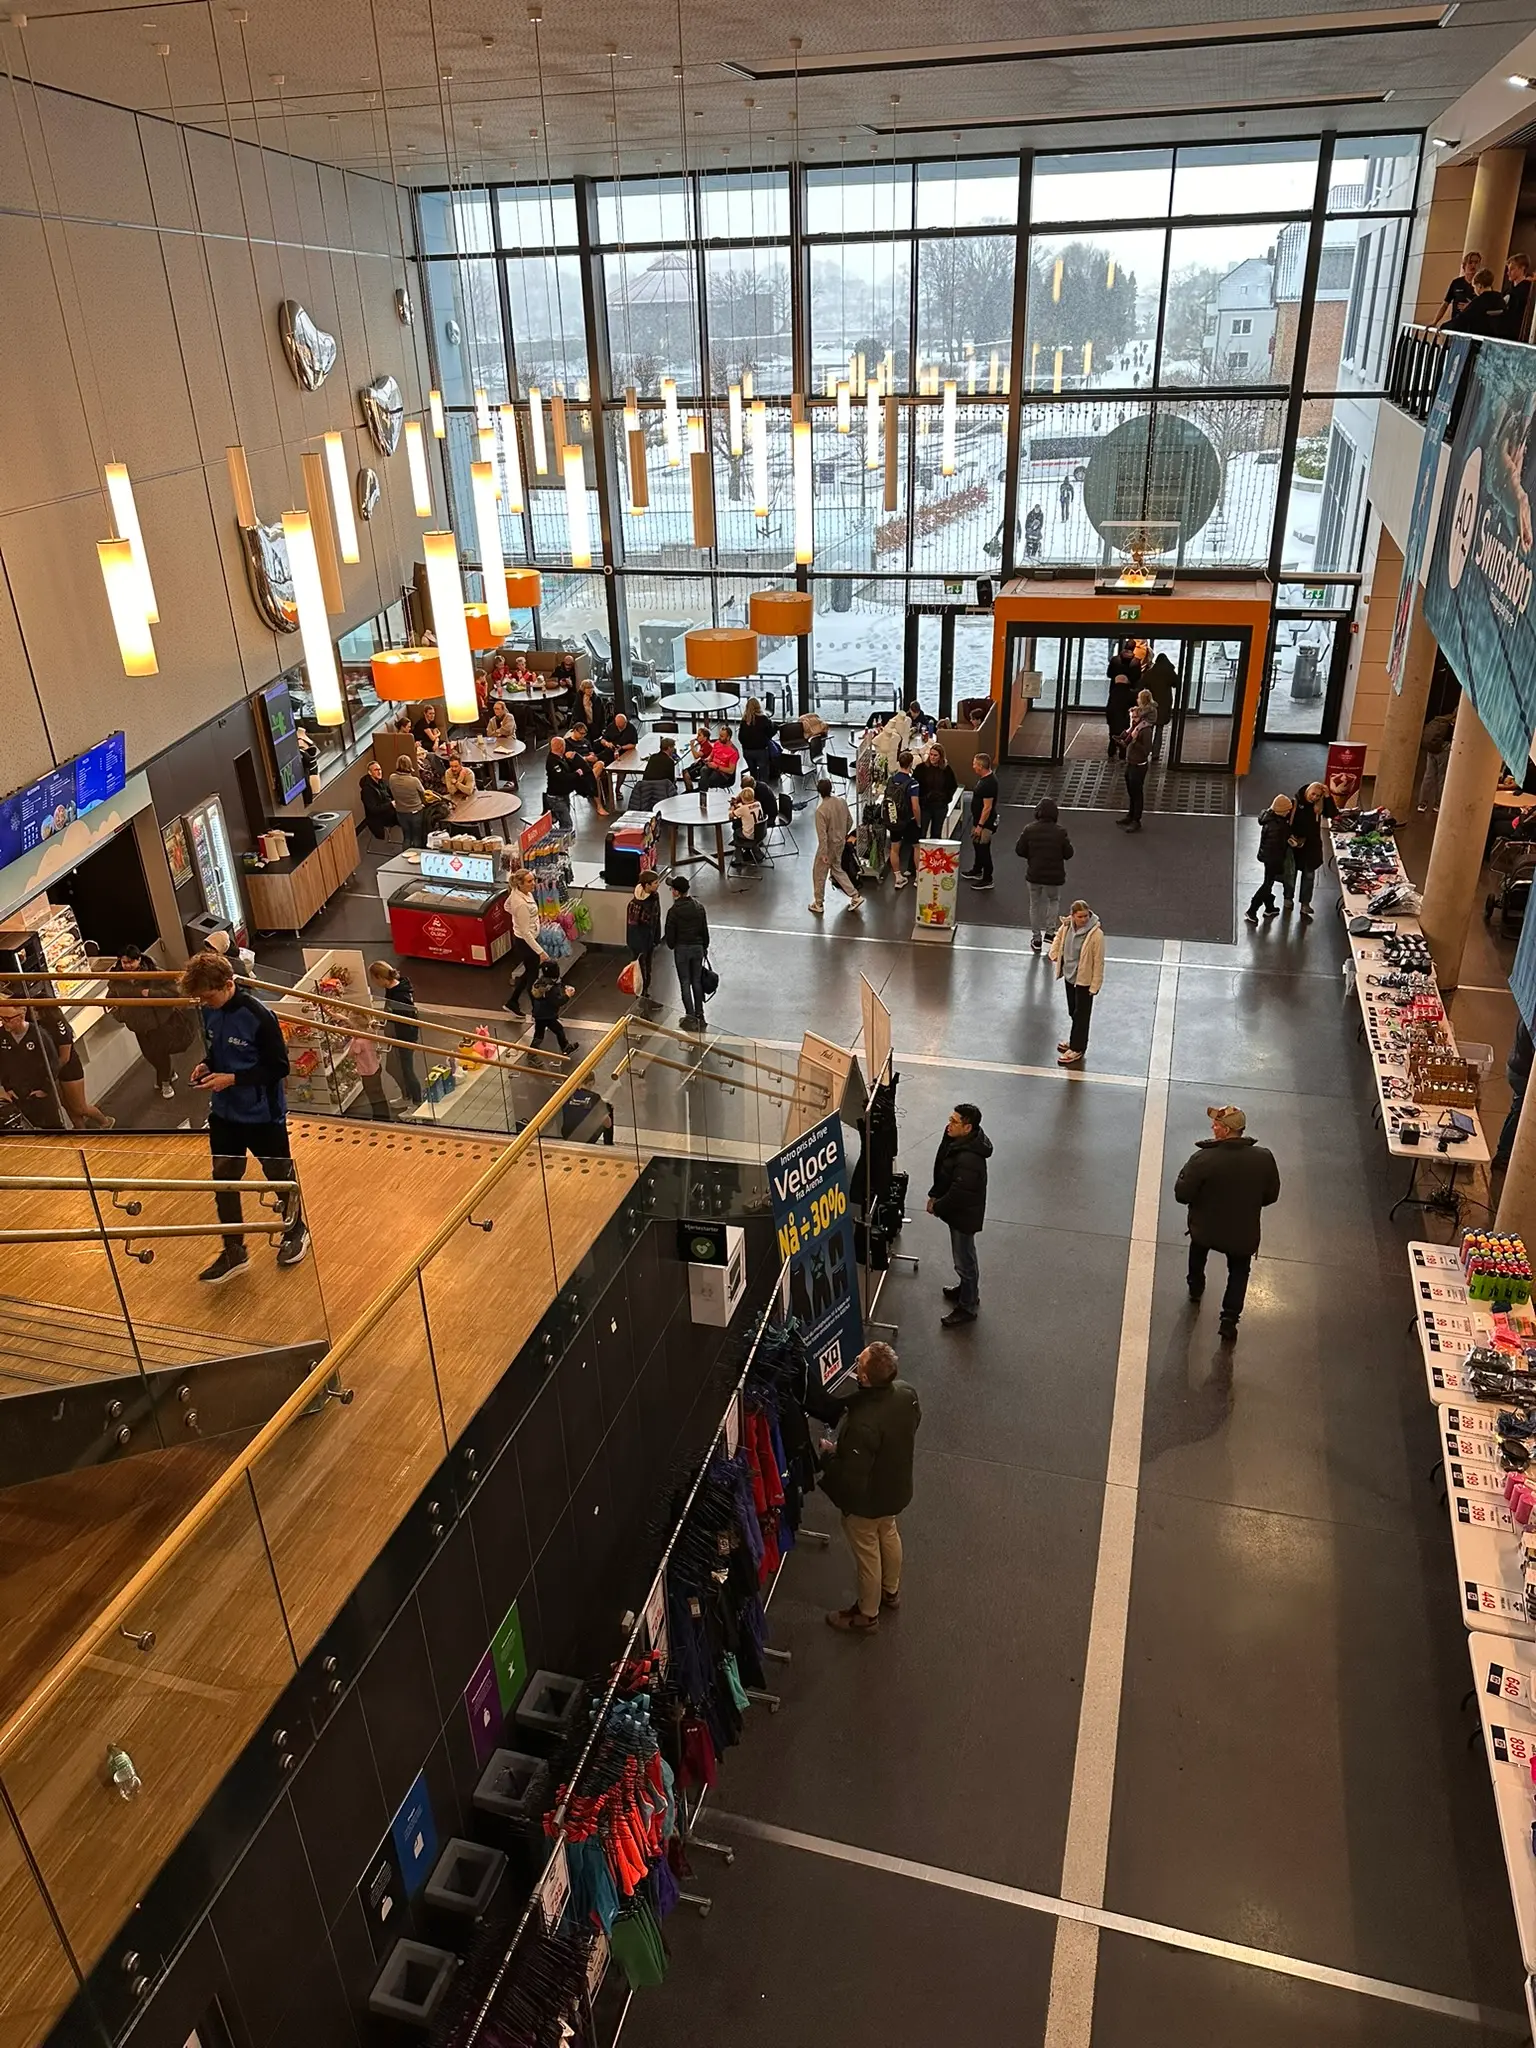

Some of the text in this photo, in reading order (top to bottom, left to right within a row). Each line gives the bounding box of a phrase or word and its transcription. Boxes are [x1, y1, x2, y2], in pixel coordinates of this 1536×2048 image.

[1475, 509, 1533, 614] Swimshop
[780, 1125, 829, 1166] Intro pris på nye
[773, 1139, 838, 1202] Veloce
[795, 1174, 824, 1202] fra Arena
[777, 1211, 801, 1263] Nå
[1471, 1505, 1486, 1522] 399
[1481, 1591, 1497, 1609] 449
[1504, 1676, 1521, 1697] 649
[1509, 1736, 1527, 1759] 899
